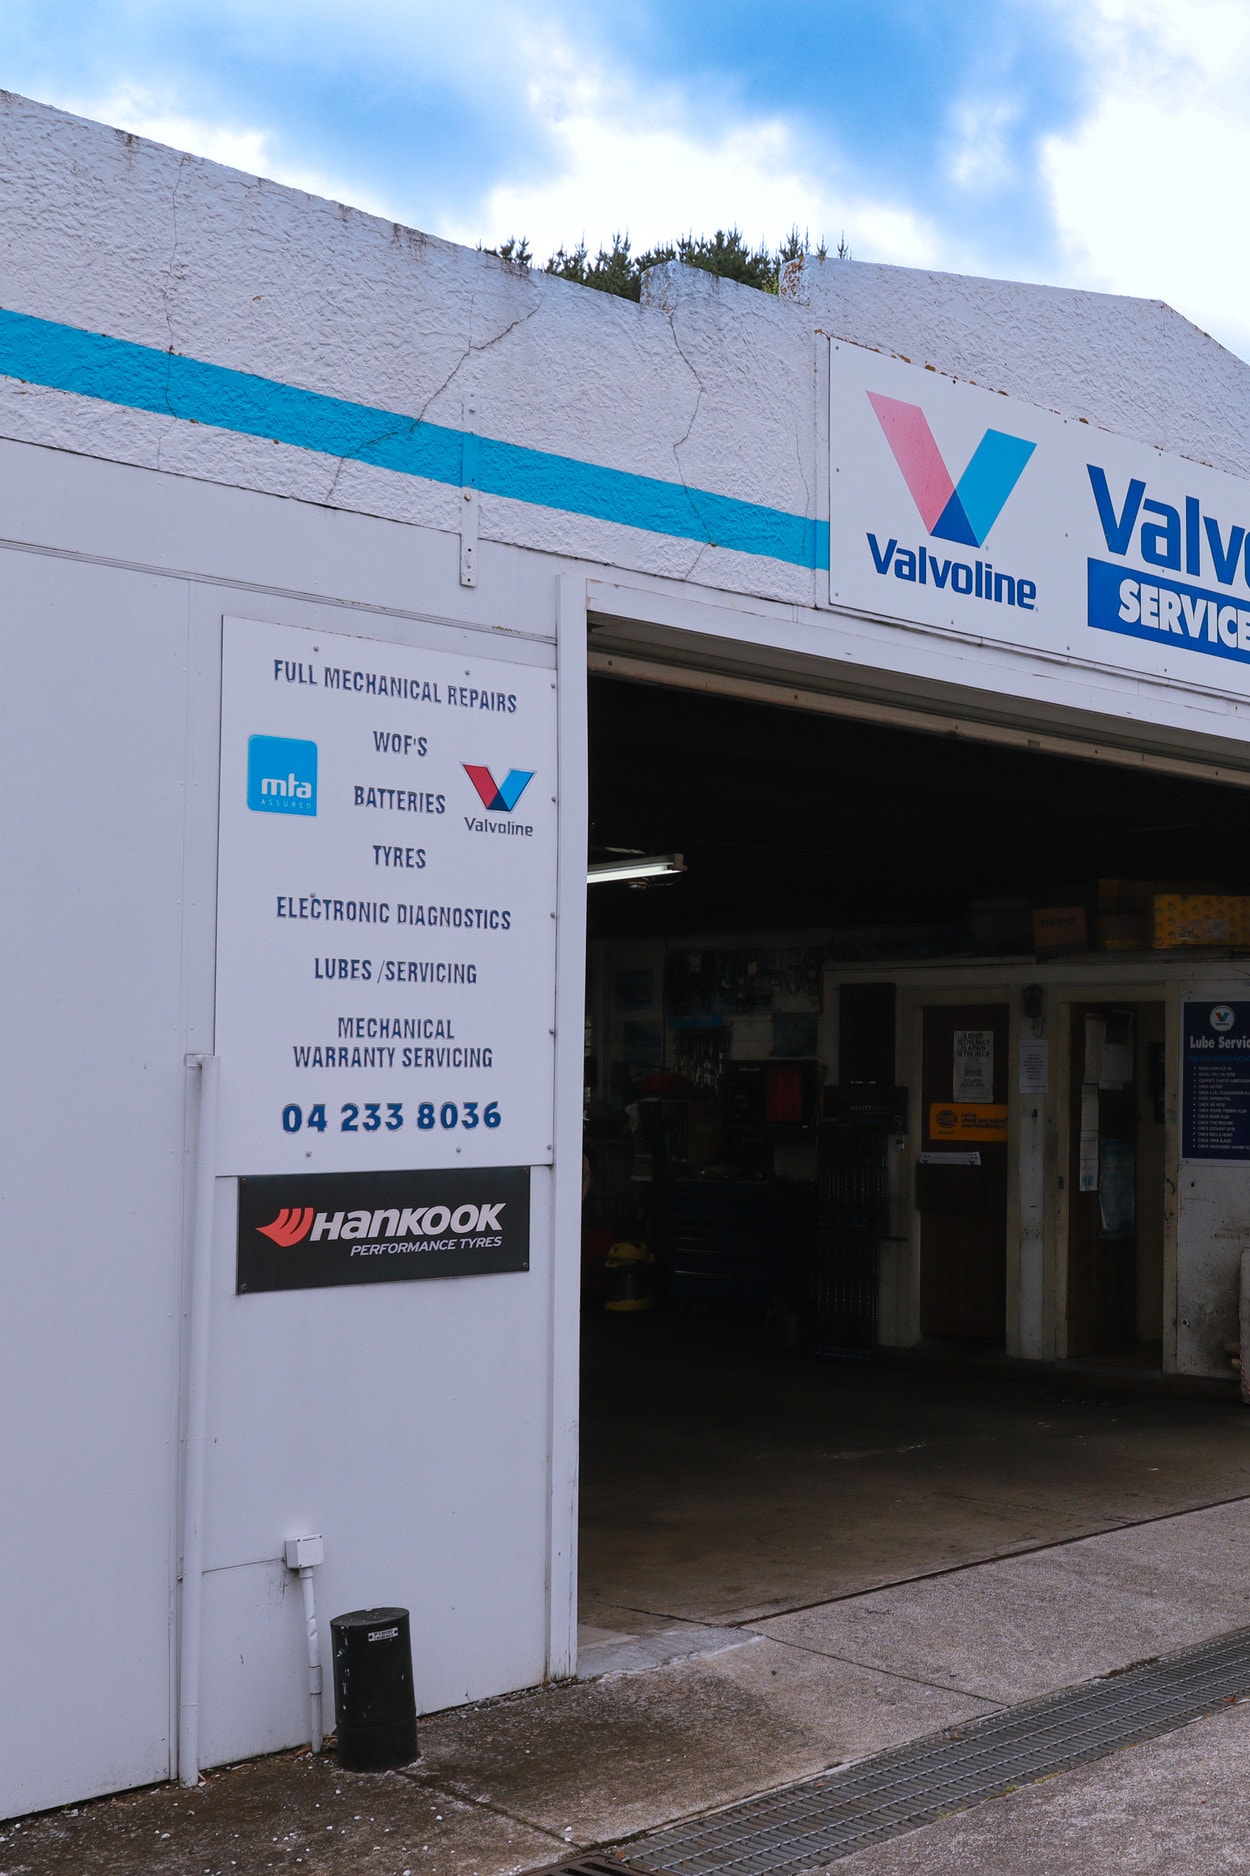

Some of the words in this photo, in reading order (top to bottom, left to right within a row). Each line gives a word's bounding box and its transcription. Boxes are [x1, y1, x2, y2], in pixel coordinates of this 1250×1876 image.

[866, 532, 1036, 610] Valvoline
[273, 659, 318, 686] FULL
[324, 667, 441, 704] MECHANICAL
[448, 685, 517, 713] REPAIRS
[373, 731, 428, 756] WOF'S
[261, 773, 312, 799] mta
[261, 799, 312, 810] ASSURED
[354, 786, 446, 814] BATTERIES
[464, 817, 533, 837] Valvoline
[373, 845, 426, 869] TYRES
[276, 896, 390, 923] ELECTRONIC
[397, 903, 511, 930] DIAGNOSTICS
[314, 957, 372, 981] LUBES
[338, 1017, 455, 1040] MECHANICAL
[1189, 1035, 1215, 1049] Lube
[292, 1045, 396, 1068] WARRANTY
[402, 1047, 493, 1068] SERVICING
[281, 1103, 327, 1133] 04
[340, 1103, 403, 1132] 233
[417, 1101, 502, 1130] 8036
[350, 1239, 456, 1257] PERFORMANCE
[460, 1236, 503, 1250] TYRES
